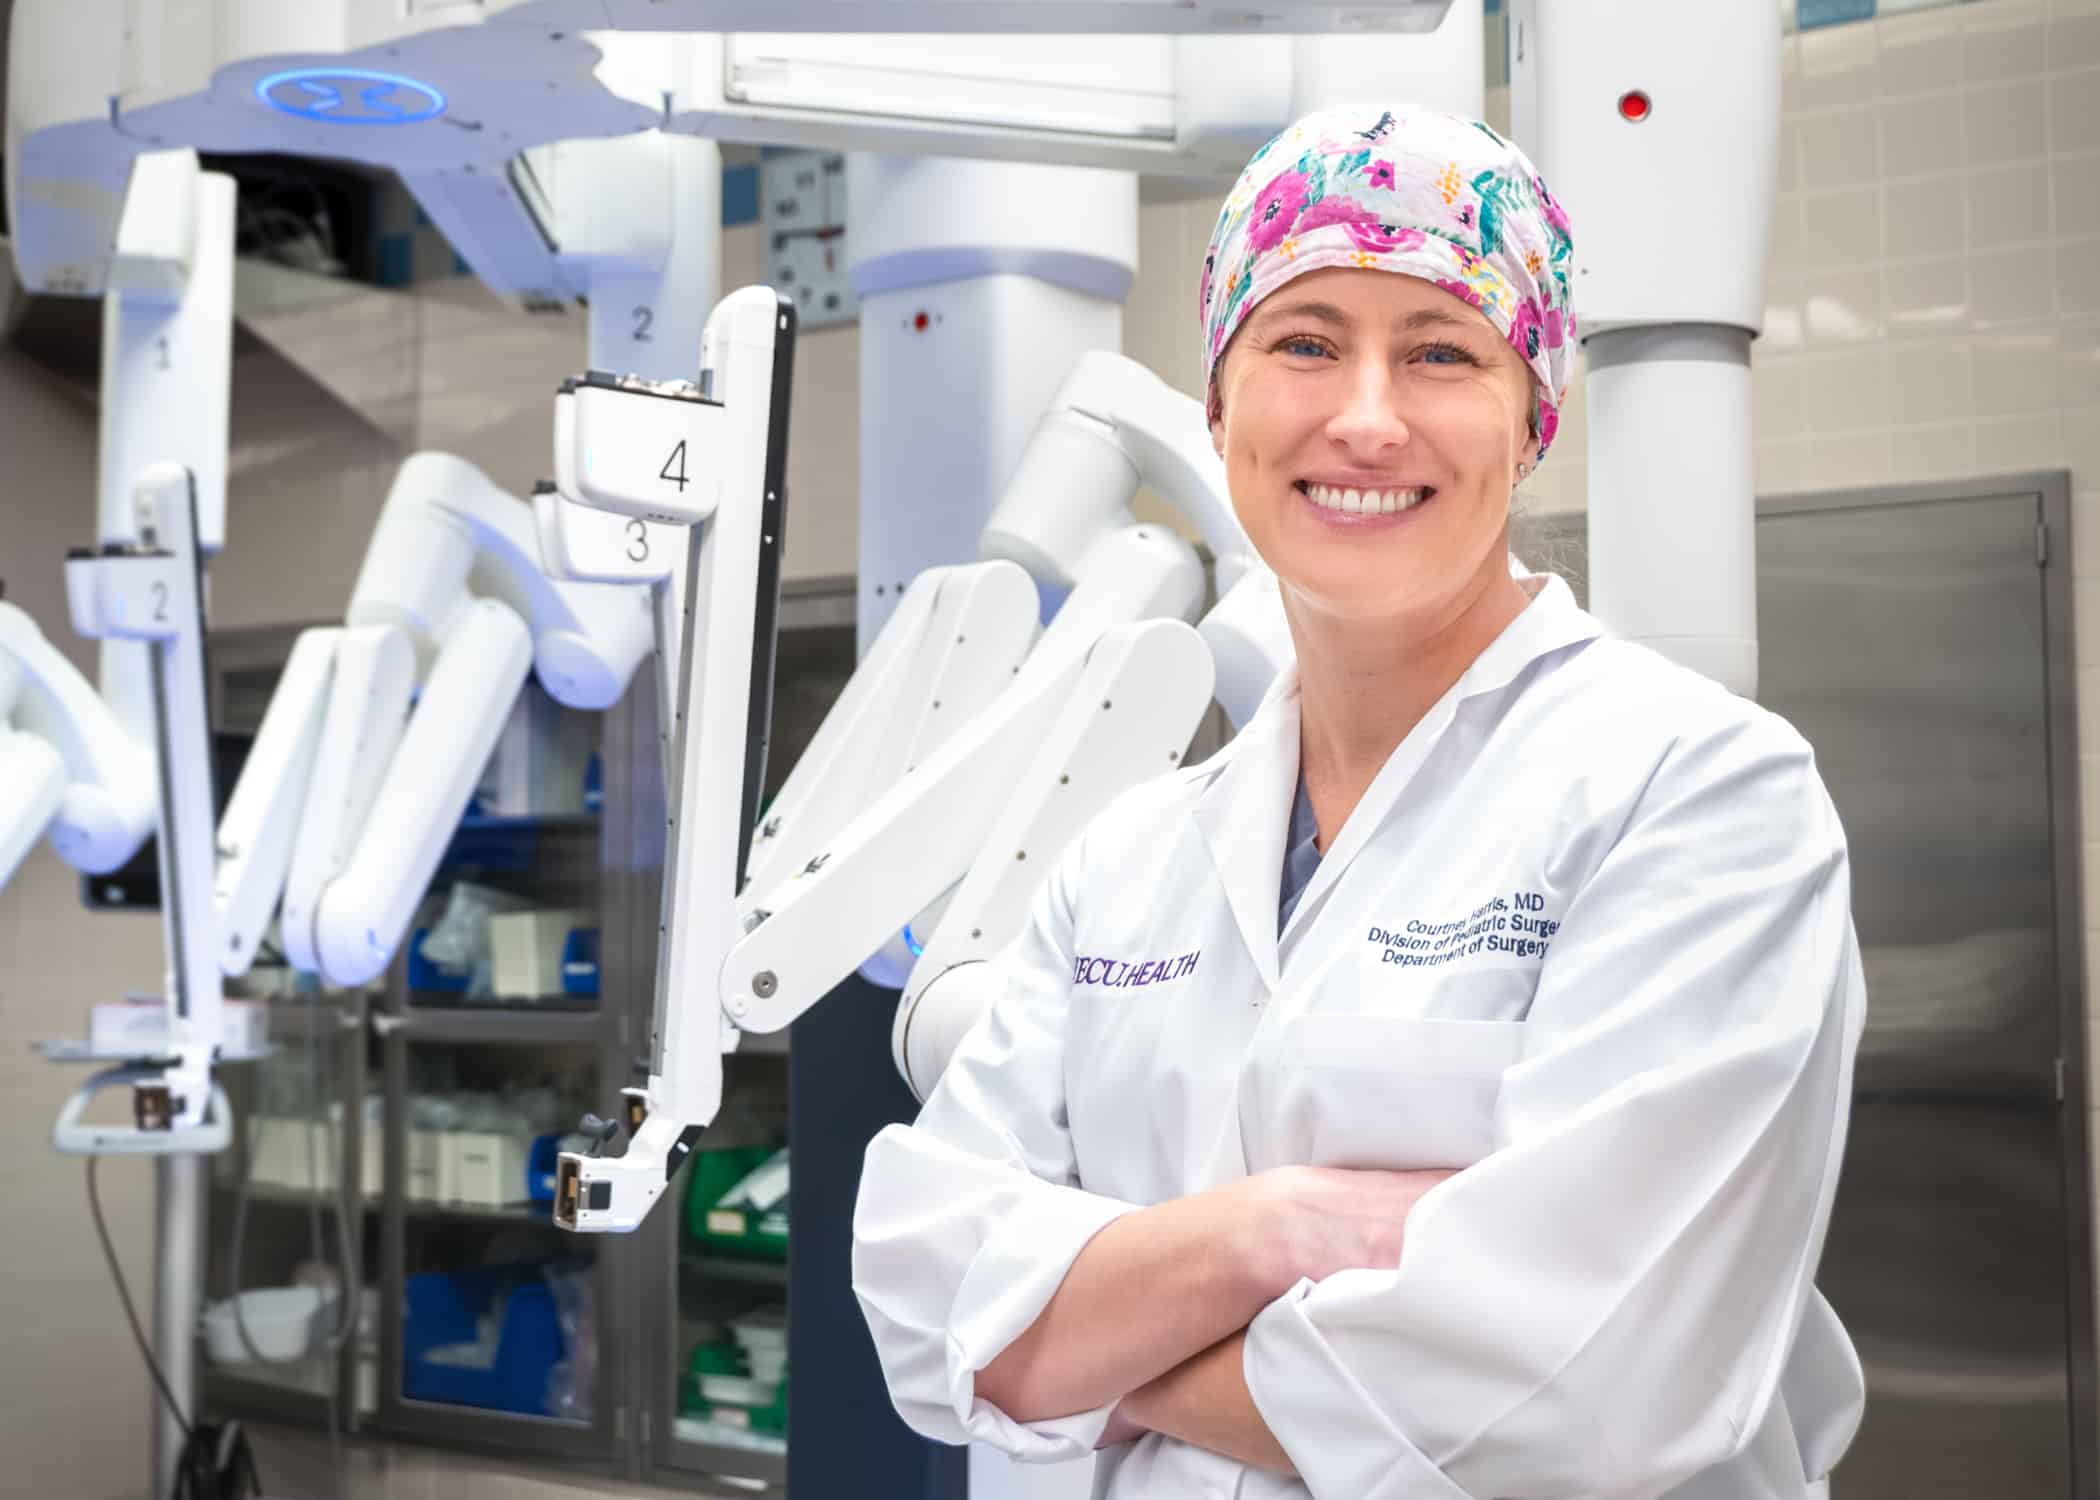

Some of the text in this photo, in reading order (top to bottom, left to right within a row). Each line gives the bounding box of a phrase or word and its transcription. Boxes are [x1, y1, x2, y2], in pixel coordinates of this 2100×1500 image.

[631, 305, 655, 342] 2
[660, 440, 690, 492] 4
[626, 519, 649, 562] 3
[150, 580, 169, 621] 2
[1514, 892, 1544, 912] MD
[1367, 926, 1430, 951] Division
[1433, 934, 1452, 951] of
[1468, 935, 1483, 955] of
[1487, 934, 1549, 960] Surgery
